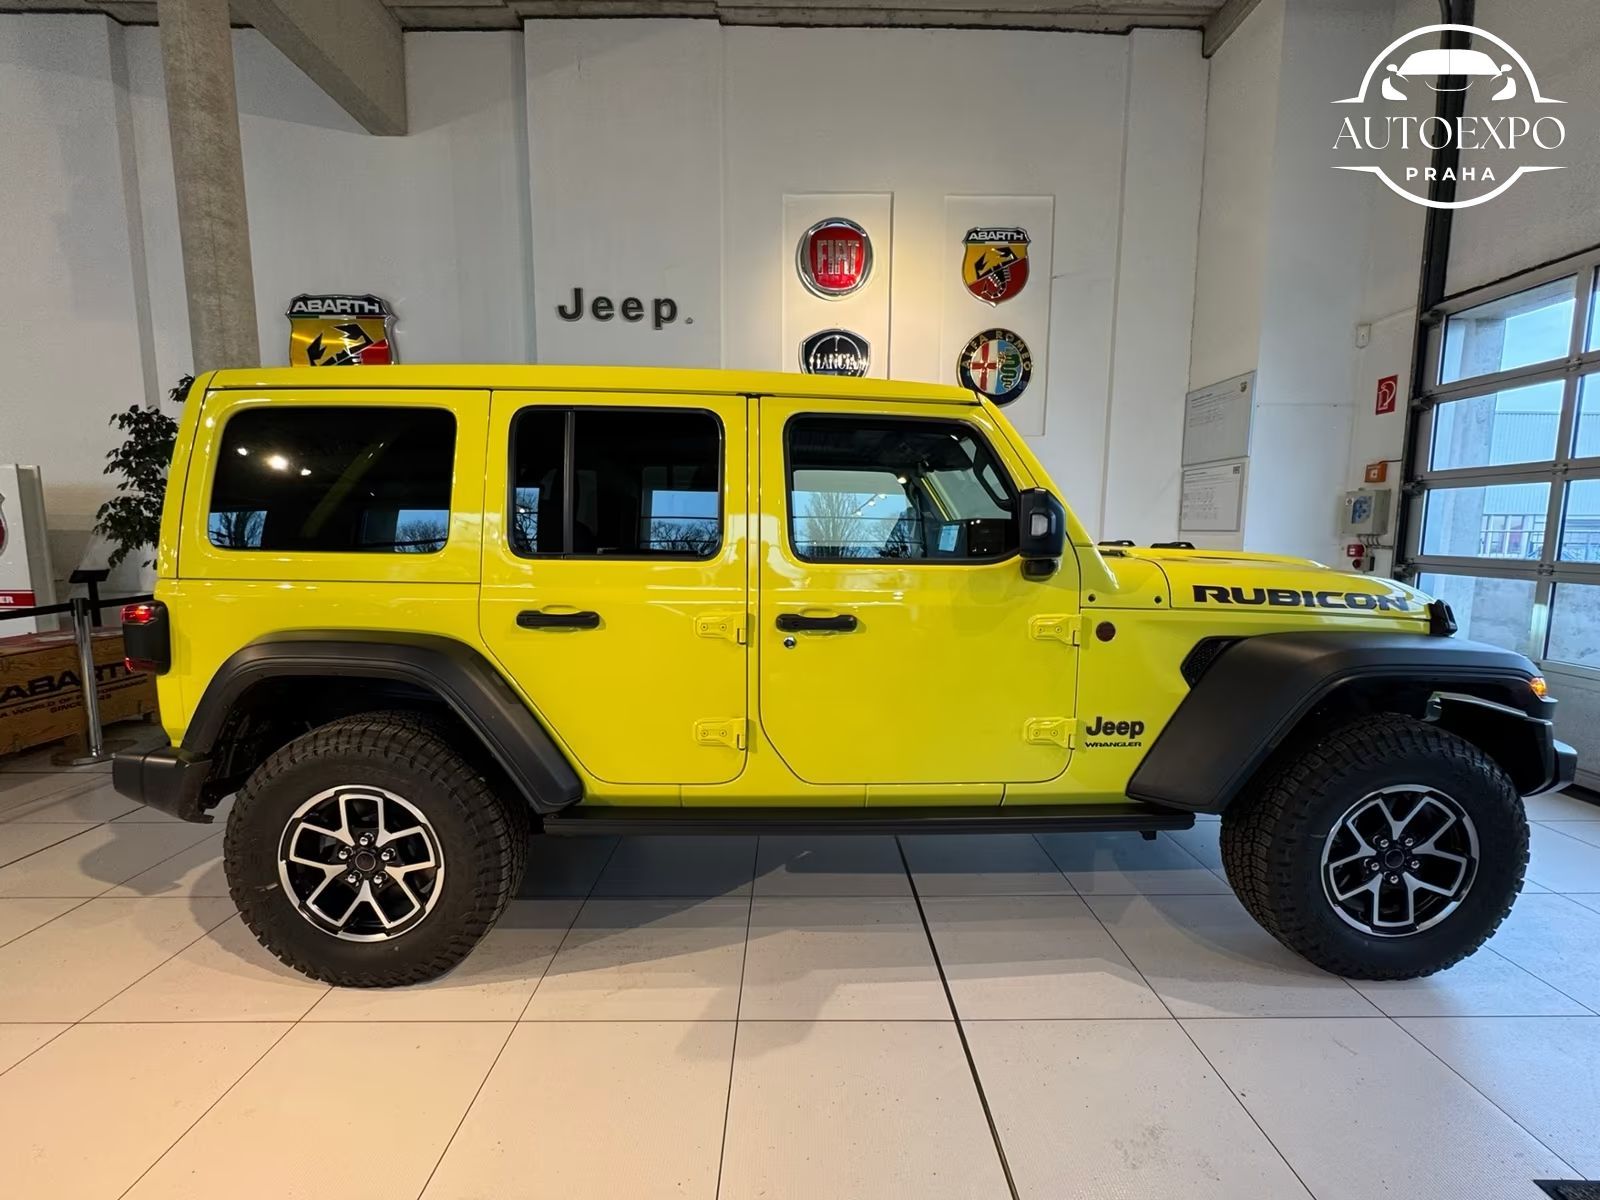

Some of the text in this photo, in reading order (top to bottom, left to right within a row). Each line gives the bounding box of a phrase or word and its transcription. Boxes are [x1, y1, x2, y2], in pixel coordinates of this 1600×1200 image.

[968, 231, 1024, 241] ABARTH
[817, 239, 860, 275] FIAT
[292, 299, 380, 313] ABARTH
[815, 353, 859, 370] LANCIA
[961, 330, 1031, 372] ALFA ROMEO
[1192, 585, 1409, 611] RUBICON
[1086, 716, 1144, 739] Jeep
